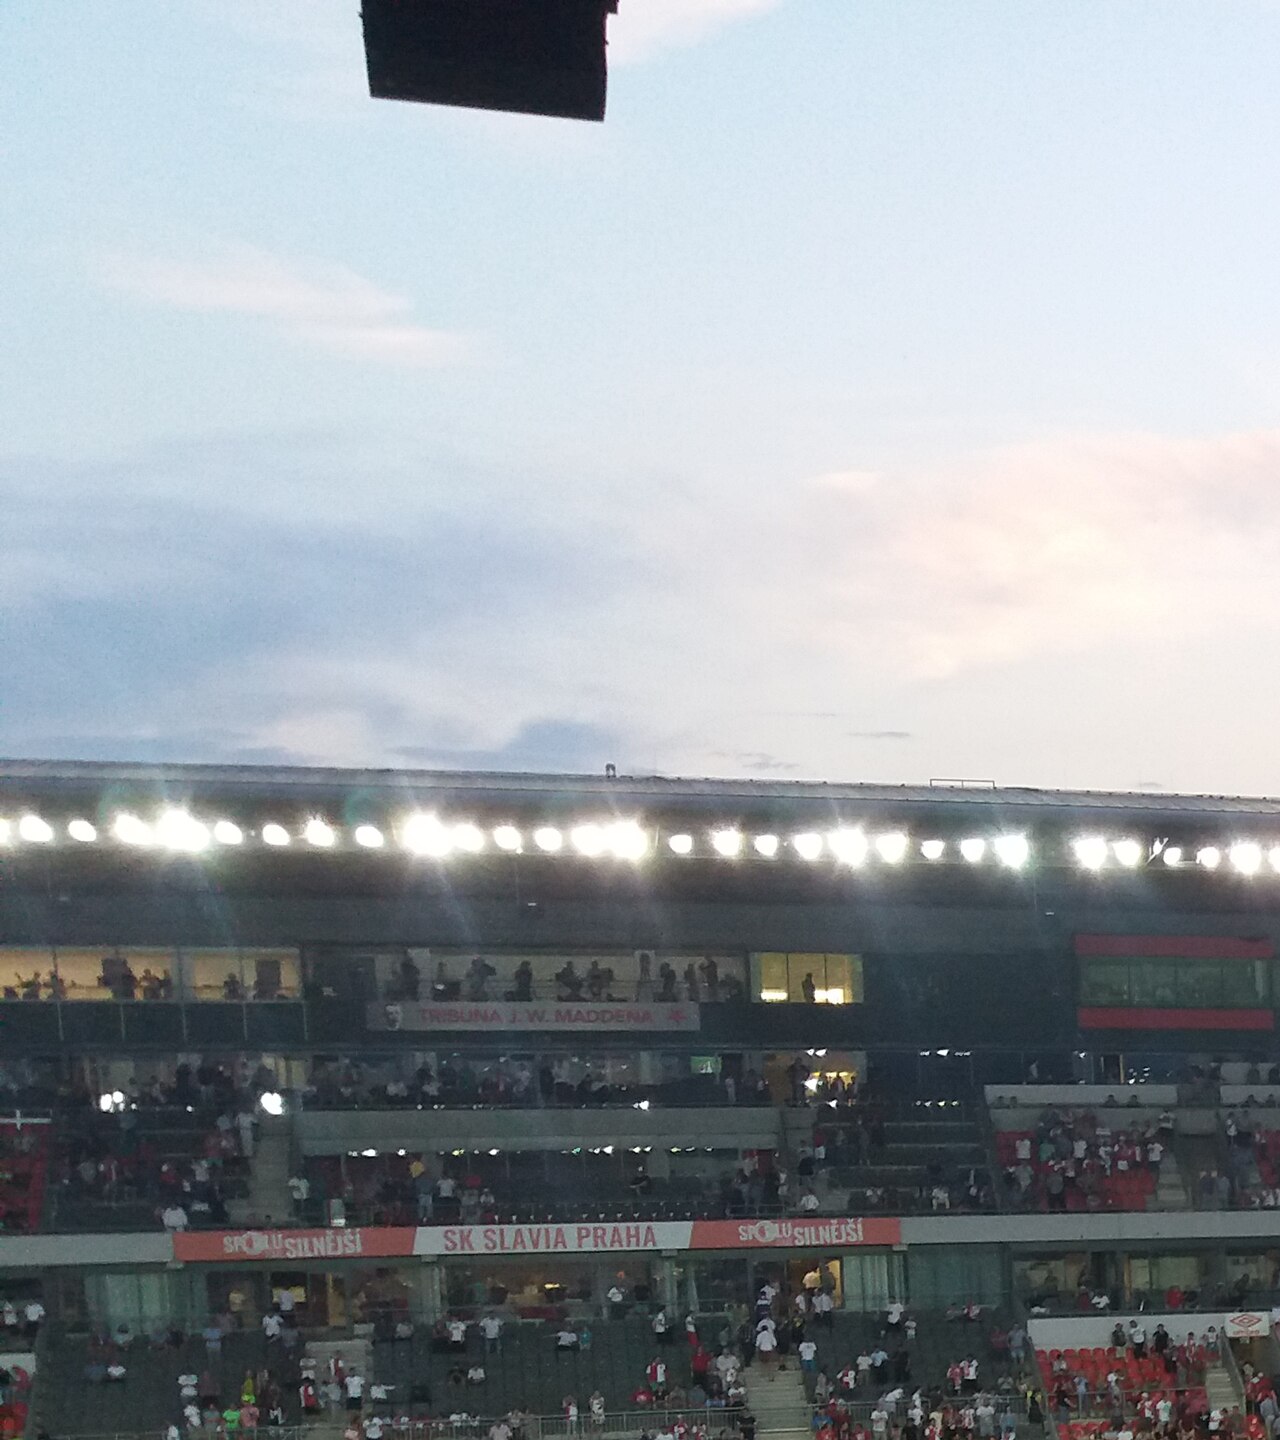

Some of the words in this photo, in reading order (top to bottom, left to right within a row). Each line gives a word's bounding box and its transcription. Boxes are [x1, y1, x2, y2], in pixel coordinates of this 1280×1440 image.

[420, 1008, 501, 1024] TRIBUNA
[526, 1009, 549, 1023] W.
[554, 1008, 653, 1023] MADDENA
[443, 1228, 472, 1252] SK
[483, 1227, 567, 1251] SLAVIA
[576, 1224, 657, 1249] PRAHA
